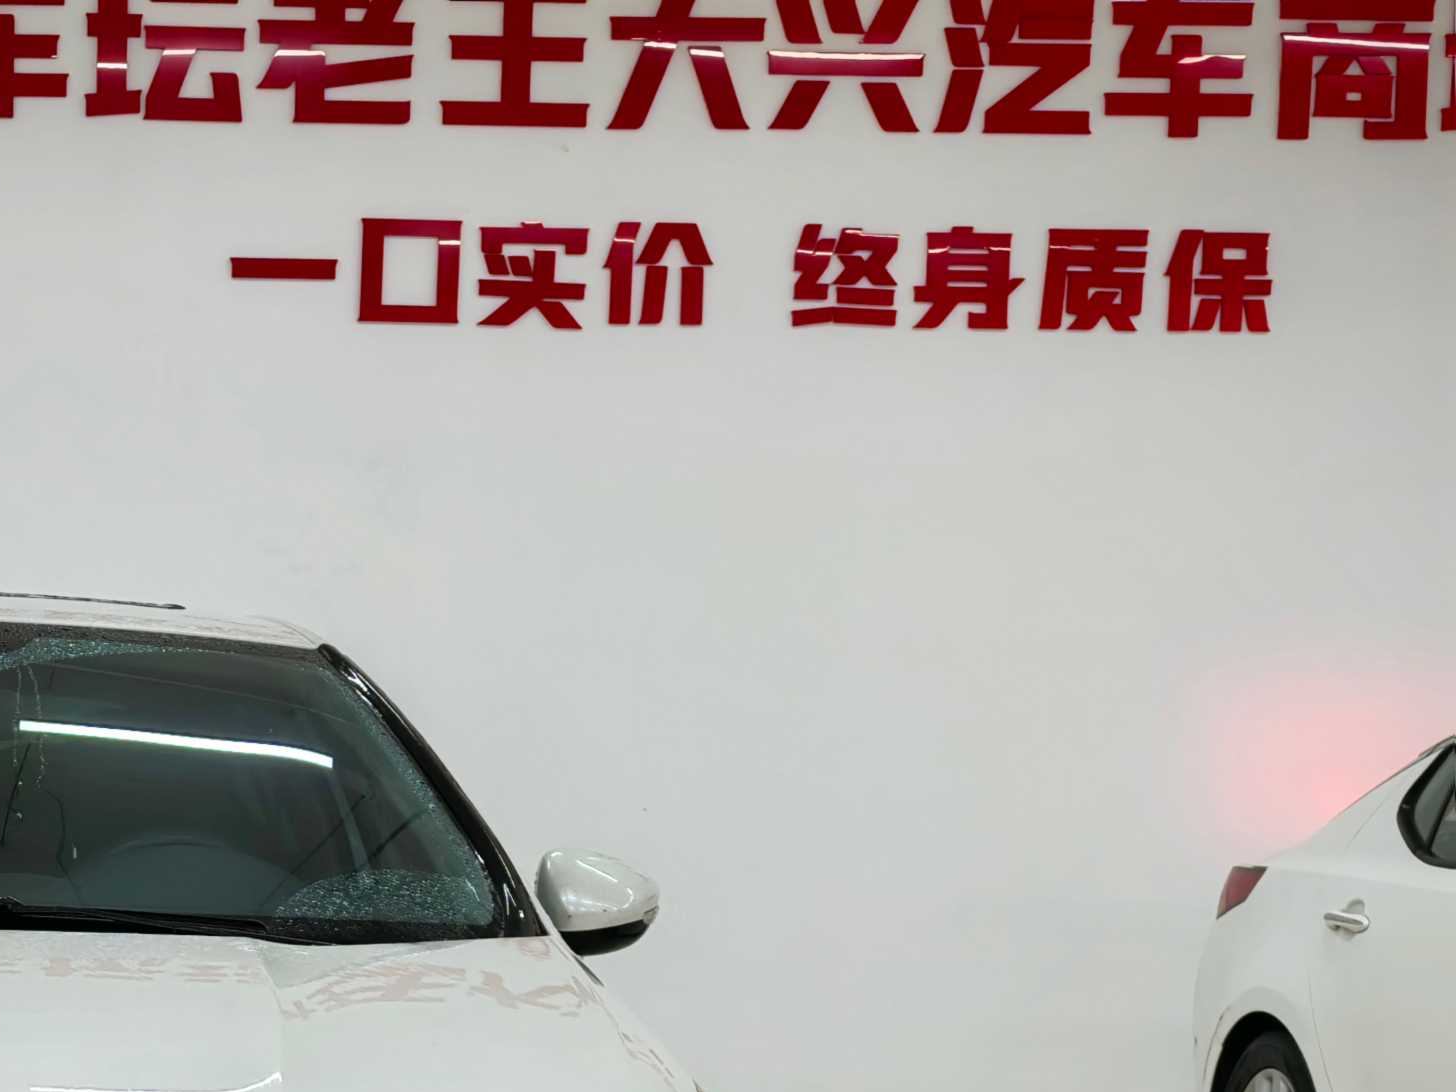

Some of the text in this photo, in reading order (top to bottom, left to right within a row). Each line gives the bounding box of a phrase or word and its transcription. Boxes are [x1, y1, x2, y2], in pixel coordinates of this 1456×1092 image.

[230, 217, 1273, 333] 一口实价 终身质保
